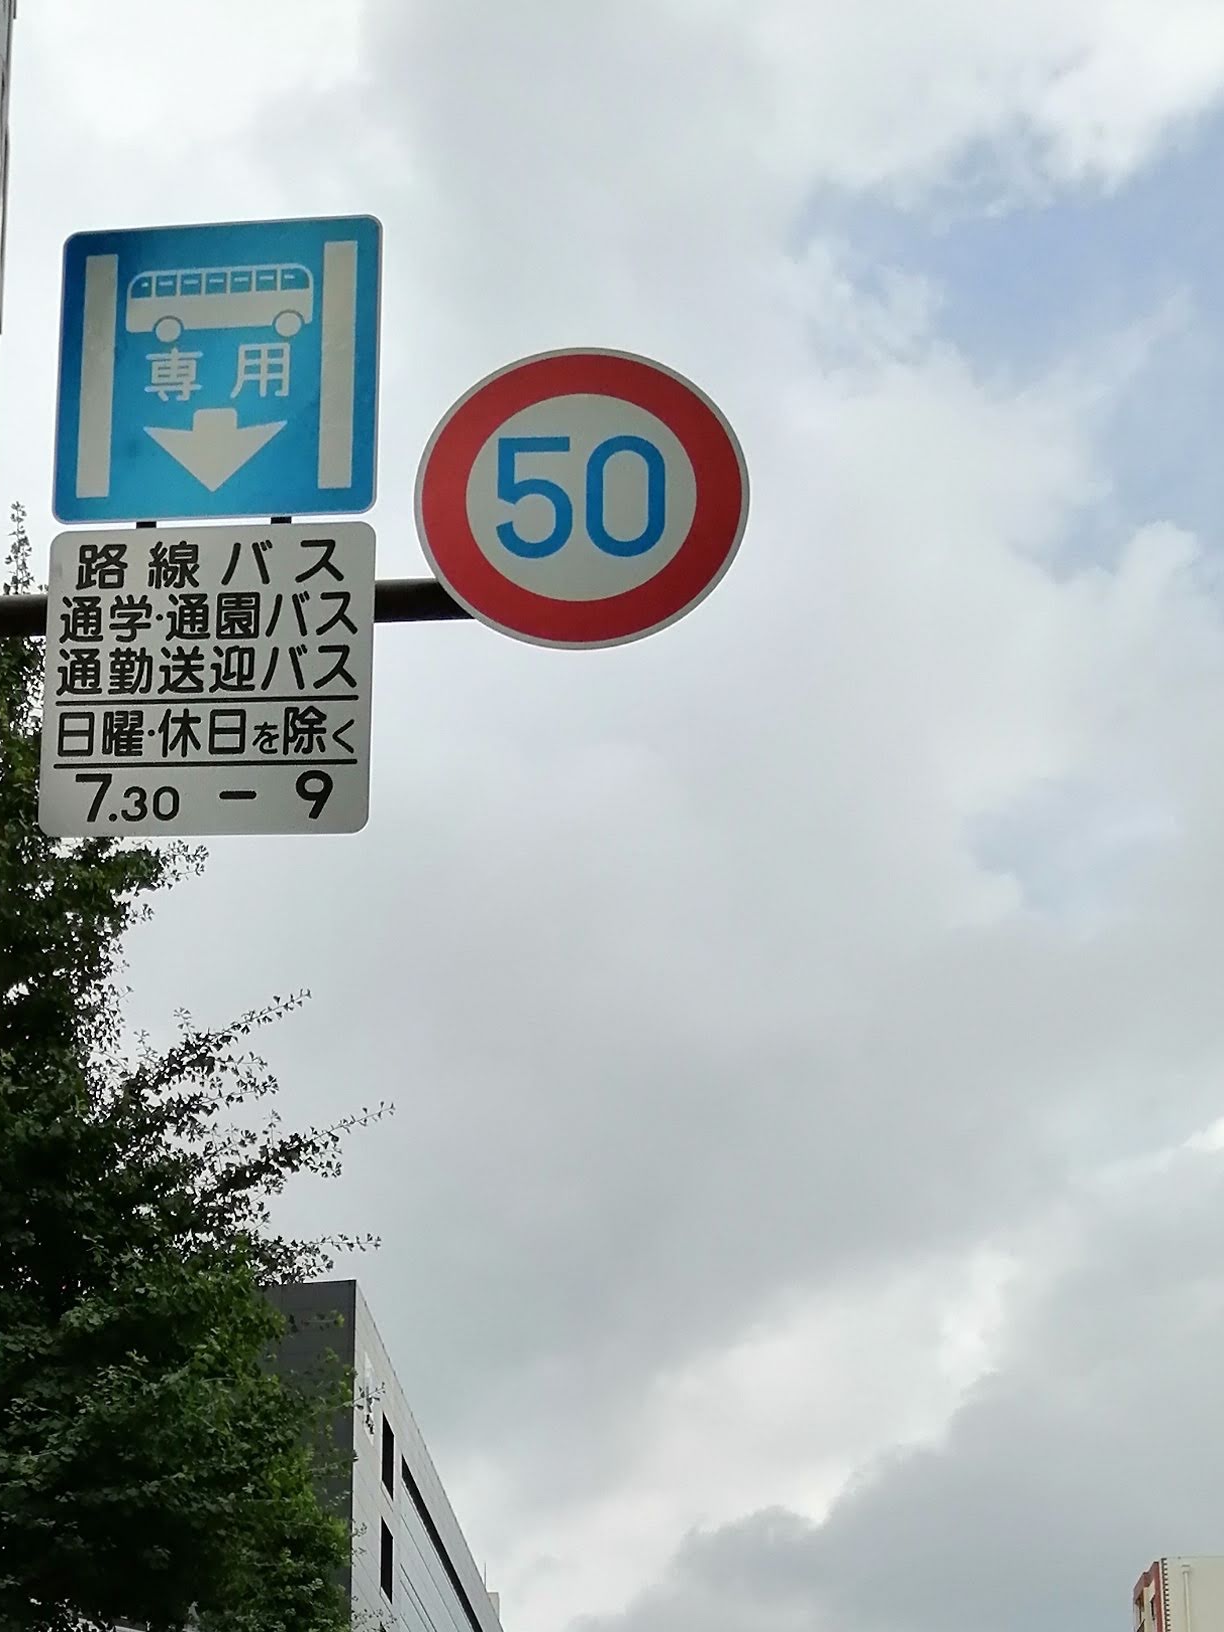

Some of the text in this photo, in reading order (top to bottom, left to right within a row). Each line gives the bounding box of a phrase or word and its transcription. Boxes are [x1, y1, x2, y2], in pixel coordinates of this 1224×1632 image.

[145, 342, 291, 402] 専用
[495, 435, 666, 558] 50
[77, 539, 344, 590] 路線バス
[57, 645, 358, 696] 通勤送迎バス
[57, 707, 356, 758] 日曜・休日を除く
